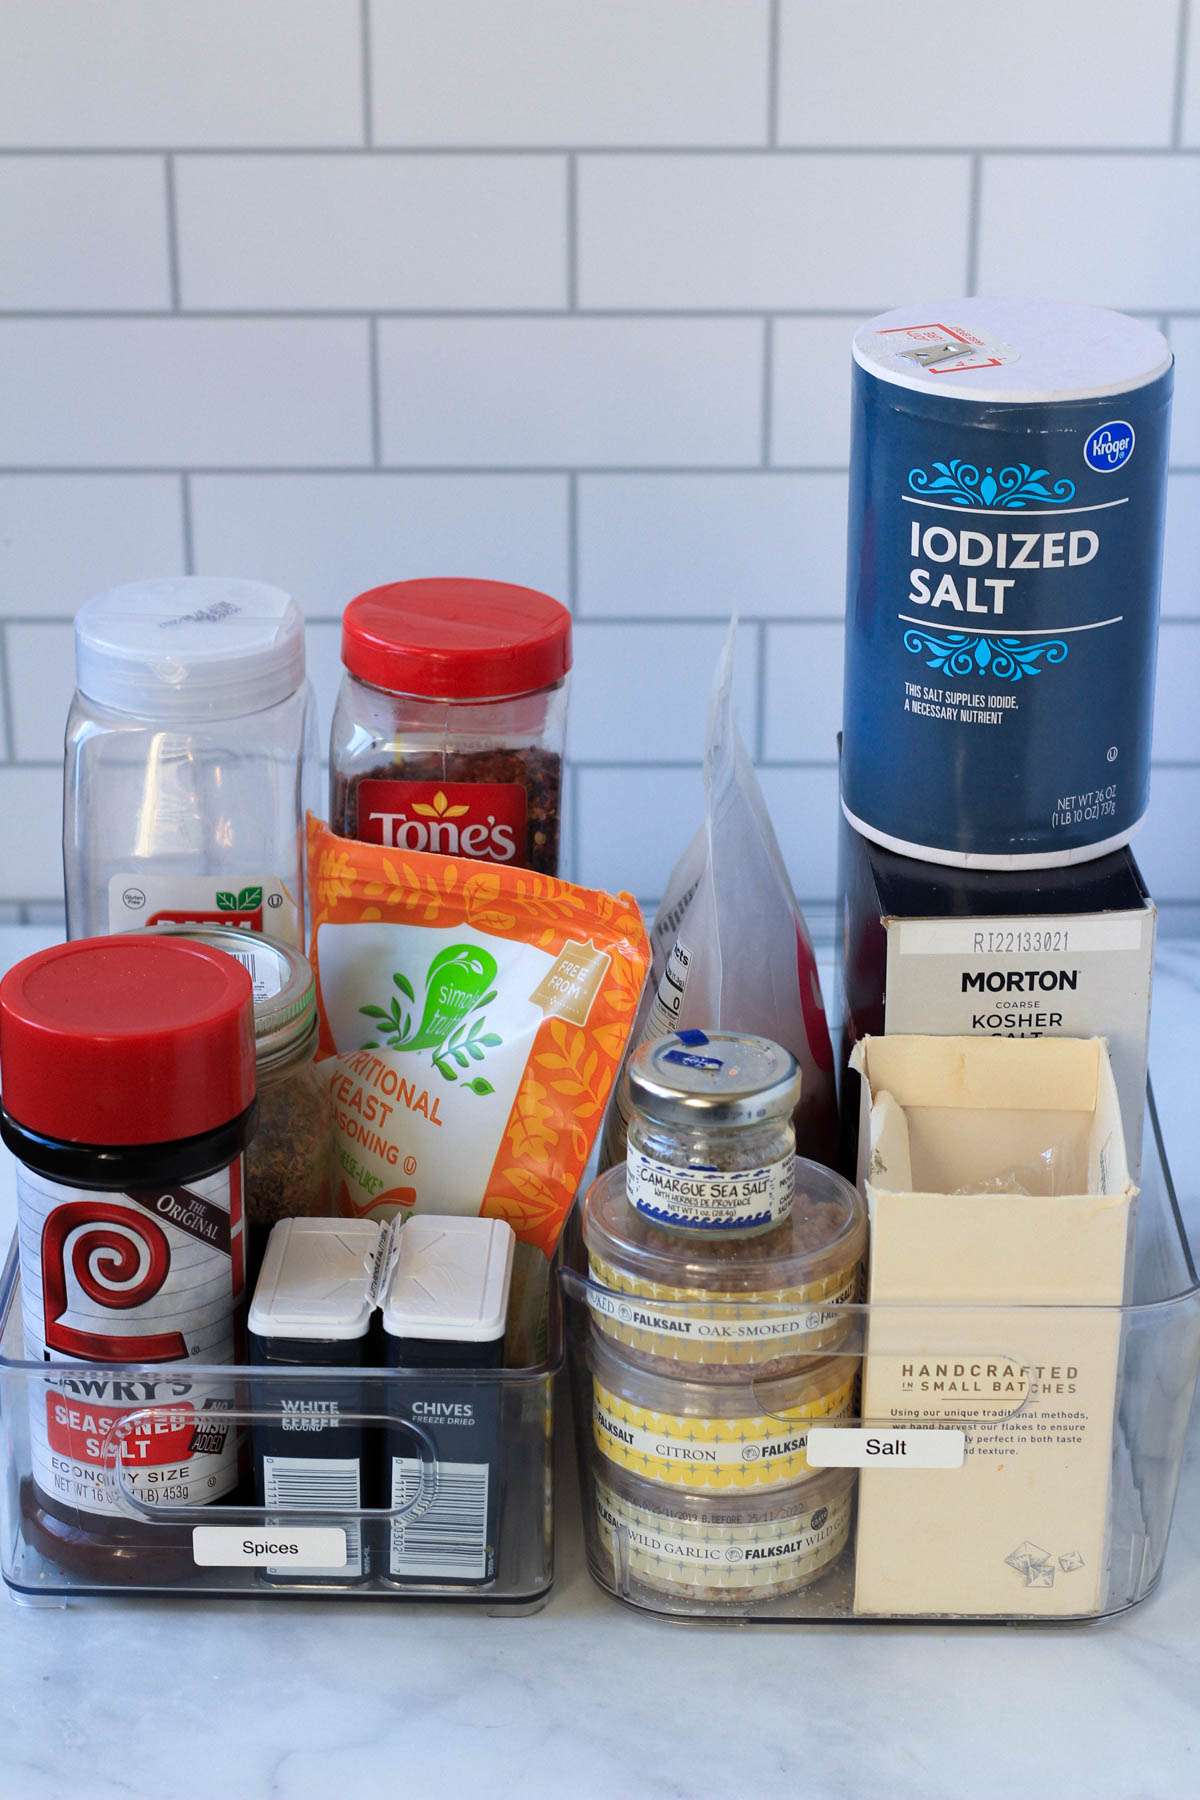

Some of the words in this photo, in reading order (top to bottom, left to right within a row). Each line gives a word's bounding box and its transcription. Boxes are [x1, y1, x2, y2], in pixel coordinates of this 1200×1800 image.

[1092, 430, 1131, 463] Kroger
[910, 521, 1100, 569] IODIZED
[908, 568, 1016, 615] SALT
[904, 682, 921, 698] THIS
[923, 687, 943, 703] SALT
[945, 691, 985, 708] SUPPLIES
[904, 698, 910, 712] A
[911, 700, 958, 721] NECESSARY
[960, 709, 1003, 725] NUTRIENT
[1057, 795, 1076, 811] NET
[1078, 792, 1094, 807] WT
[1095, 789, 1104, 804] 26
[1105, 784, 1117, 800] OZ
[1061, 812, 1071, 825] LB
[1074, 809, 1083, 823] 10
[1084, 803, 1099, 820] OZ)
[368, 812, 517, 861] Tone's
[973, 930, 1070, 953] RI22133021
[560, 960, 589, 982] FREE
[961, 970, 1078, 993] MORTON
[548, 976, 582, 999] FROM
[995, 1001, 1041, 1009] COARSE
[972, 1012, 1063, 1029] KOSHER
[329, 1070, 394, 1128] YEAST
[640, 1168, 706, 1197] CAMARGUE
[710, 1184, 738, 1198] SEA
[742, 1179, 770, 1196] SALT
[188, 1200, 207, 1217] THE
[667, 1203, 680, 1211] NET
[682, 1206, 692, 1214] WT
[633, 1312, 692, 1333] FALKSALT
[698, 1321, 800, 1337] OAK-SMOKED
[901, 1364, 1079, 1379] HANDCRAFTED
[920, 1381, 982, 1392] SMALL
[992, 1381, 1077, 1394] BATCHES
[281, 1400, 339, 1412] WHITE
[412, 1401, 473, 1416] CHIVES
[890, 1408, 920, 1418] Using
[944, 1409, 979, 1418] unique
[1041, 1411, 1089, 1420] methods,
[412, 1415, 446, 1425] FREEZE
[447, 1417, 476, 1426] DRIED
[910, 1422, 935, 1430] hand
[1001, 1423, 1033, 1431] flakes
[597, 1412, 635, 1445] FALKSALT
[655, 1444, 717, 1462] CITRON
[762, 1435, 808, 1458] FALKSA
[865, 1438, 907, 1455] Salt
[977, 1435, 1014, 1444] perfect
[1030, 1435, 1053, 1443] both
[51, 1457, 140, 1486] ECONOY
[148, 1467, 190, 1482] SIZE
[54, 1474, 70, 1493] NET
[163, 1485, 189, 1500] 453g
[241, 1540, 300, 1556] Spices
[627, 1528, 661, 1549] WILD
[664, 1542, 721, 1561] GARLIC
[745, 1540, 803, 1560] FALKSALT
